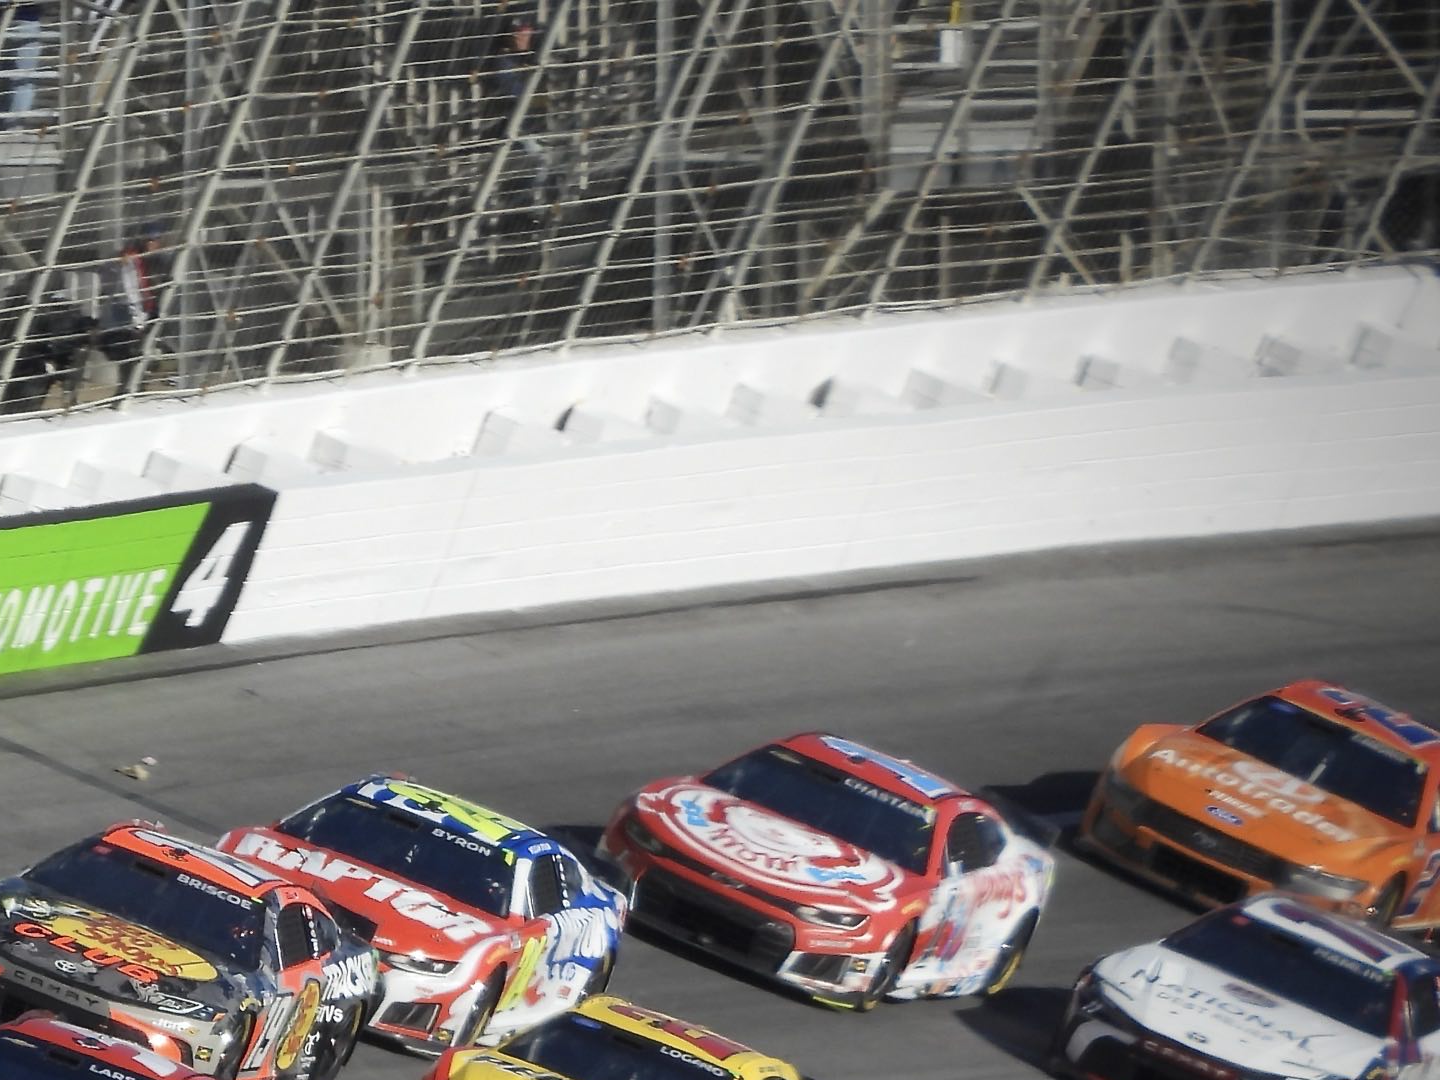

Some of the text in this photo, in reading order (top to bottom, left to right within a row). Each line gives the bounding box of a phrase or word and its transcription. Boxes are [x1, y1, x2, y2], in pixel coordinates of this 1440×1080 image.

[171, 521, 251, 627] 4
[431, 828, 491, 857] BYRON
[176, 873, 252, 910] BRISCOE
[234, 832, 493, 941] RAPTOR
[14, 922, 159, 983] CLUB
[13, 969, 100, 1006] CAMRY
[660, 1046, 724, 1077] LOGANO
